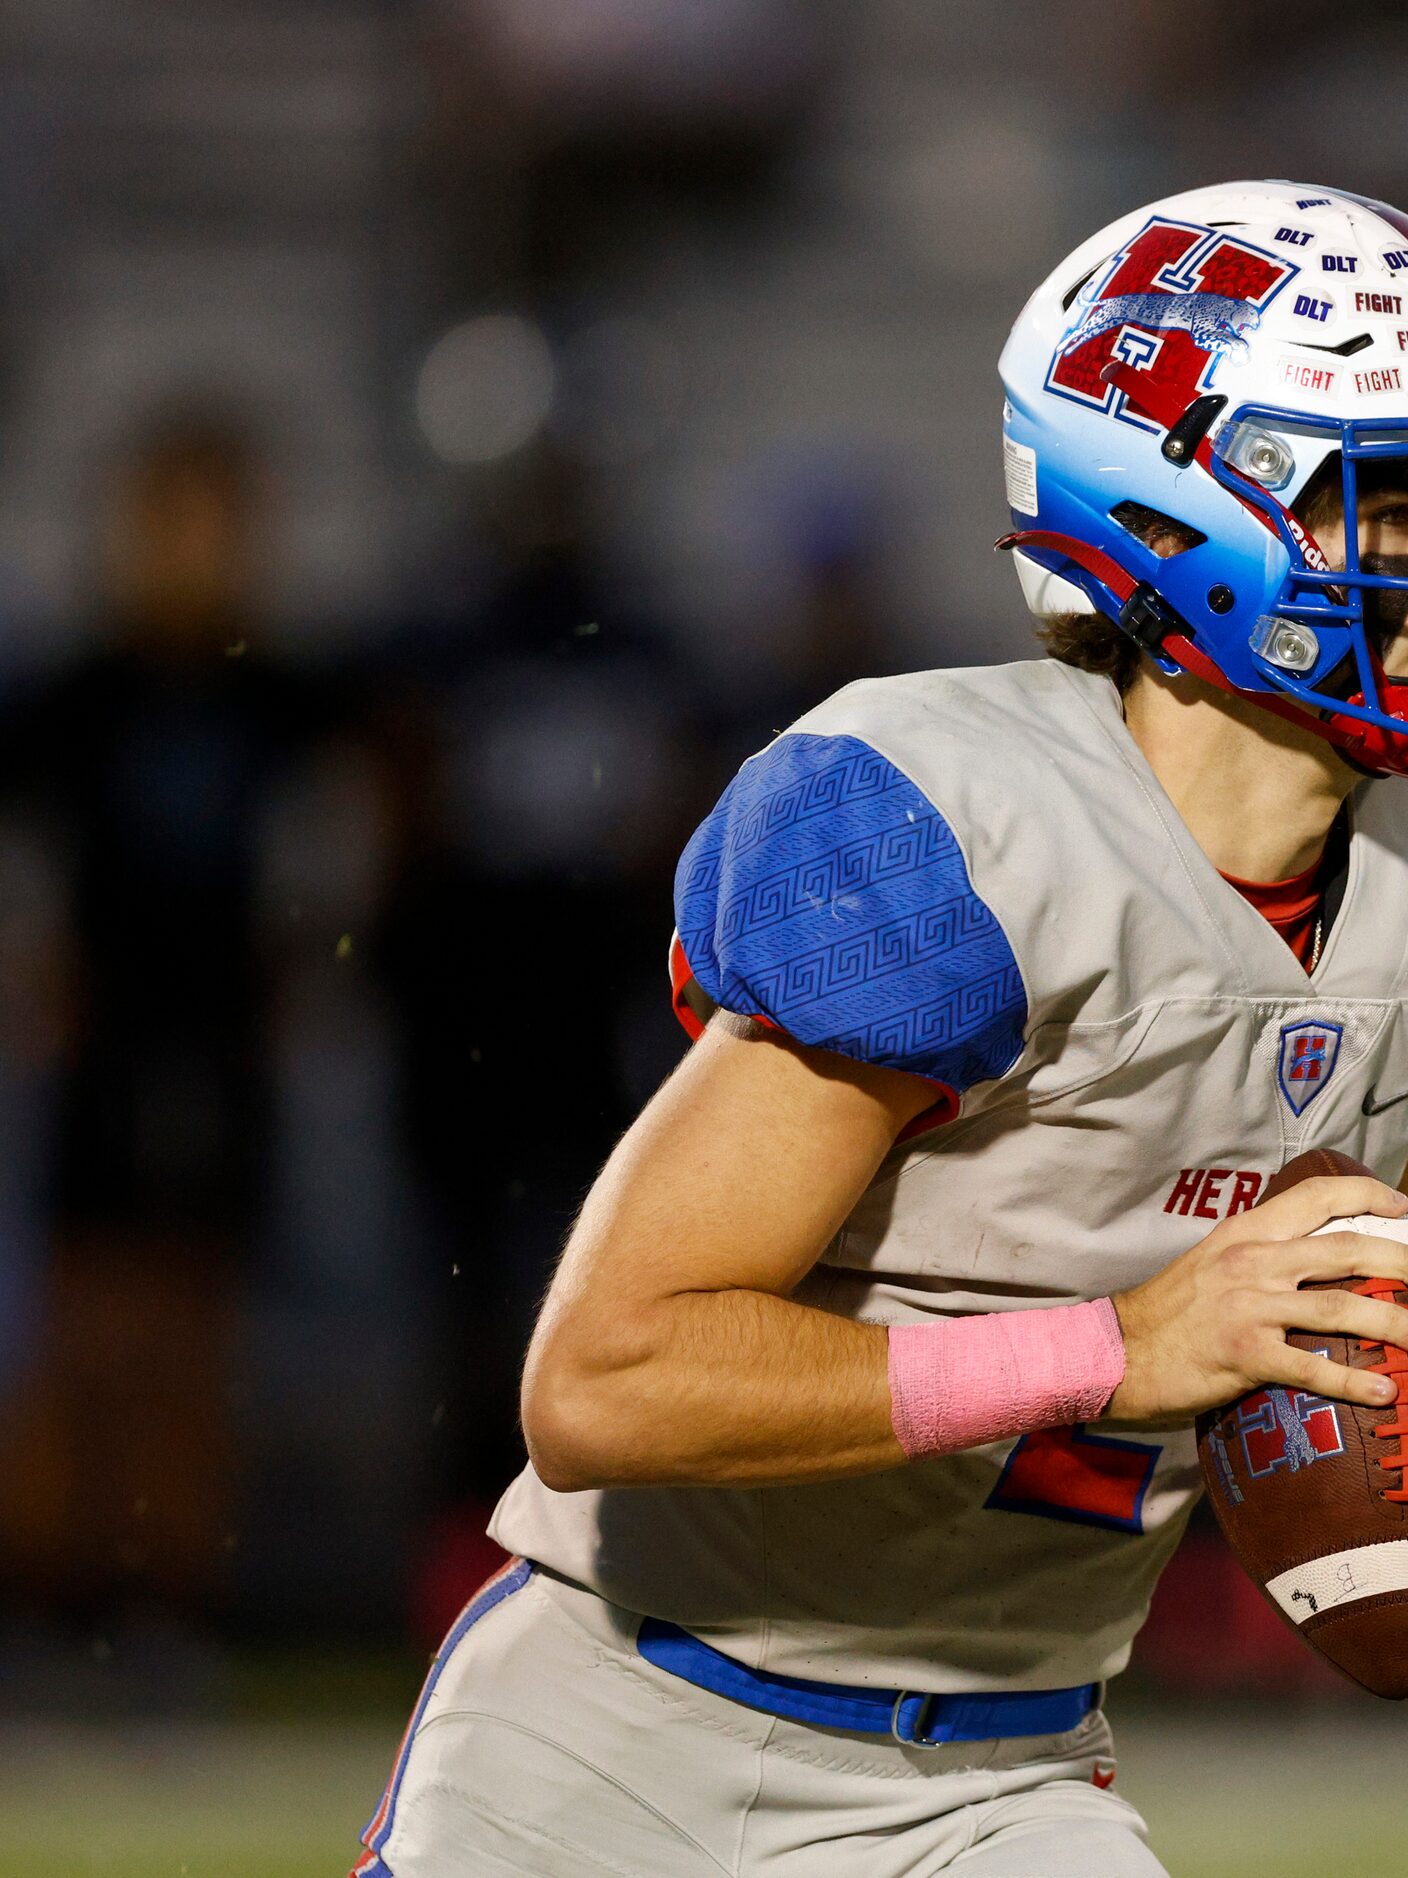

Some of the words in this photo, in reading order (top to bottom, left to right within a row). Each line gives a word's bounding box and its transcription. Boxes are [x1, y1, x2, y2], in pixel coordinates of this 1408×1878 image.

[1274, 227, 1314, 247] DLT
[1322, 254, 1357, 273] DLT
[1293, 295, 1333, 322] DLT
[1355, 292, 1403, 316] FIGHT
[1285, 364, 1334, 392] FIGHT
[1355, 368, 1401, 393] FIGHT
